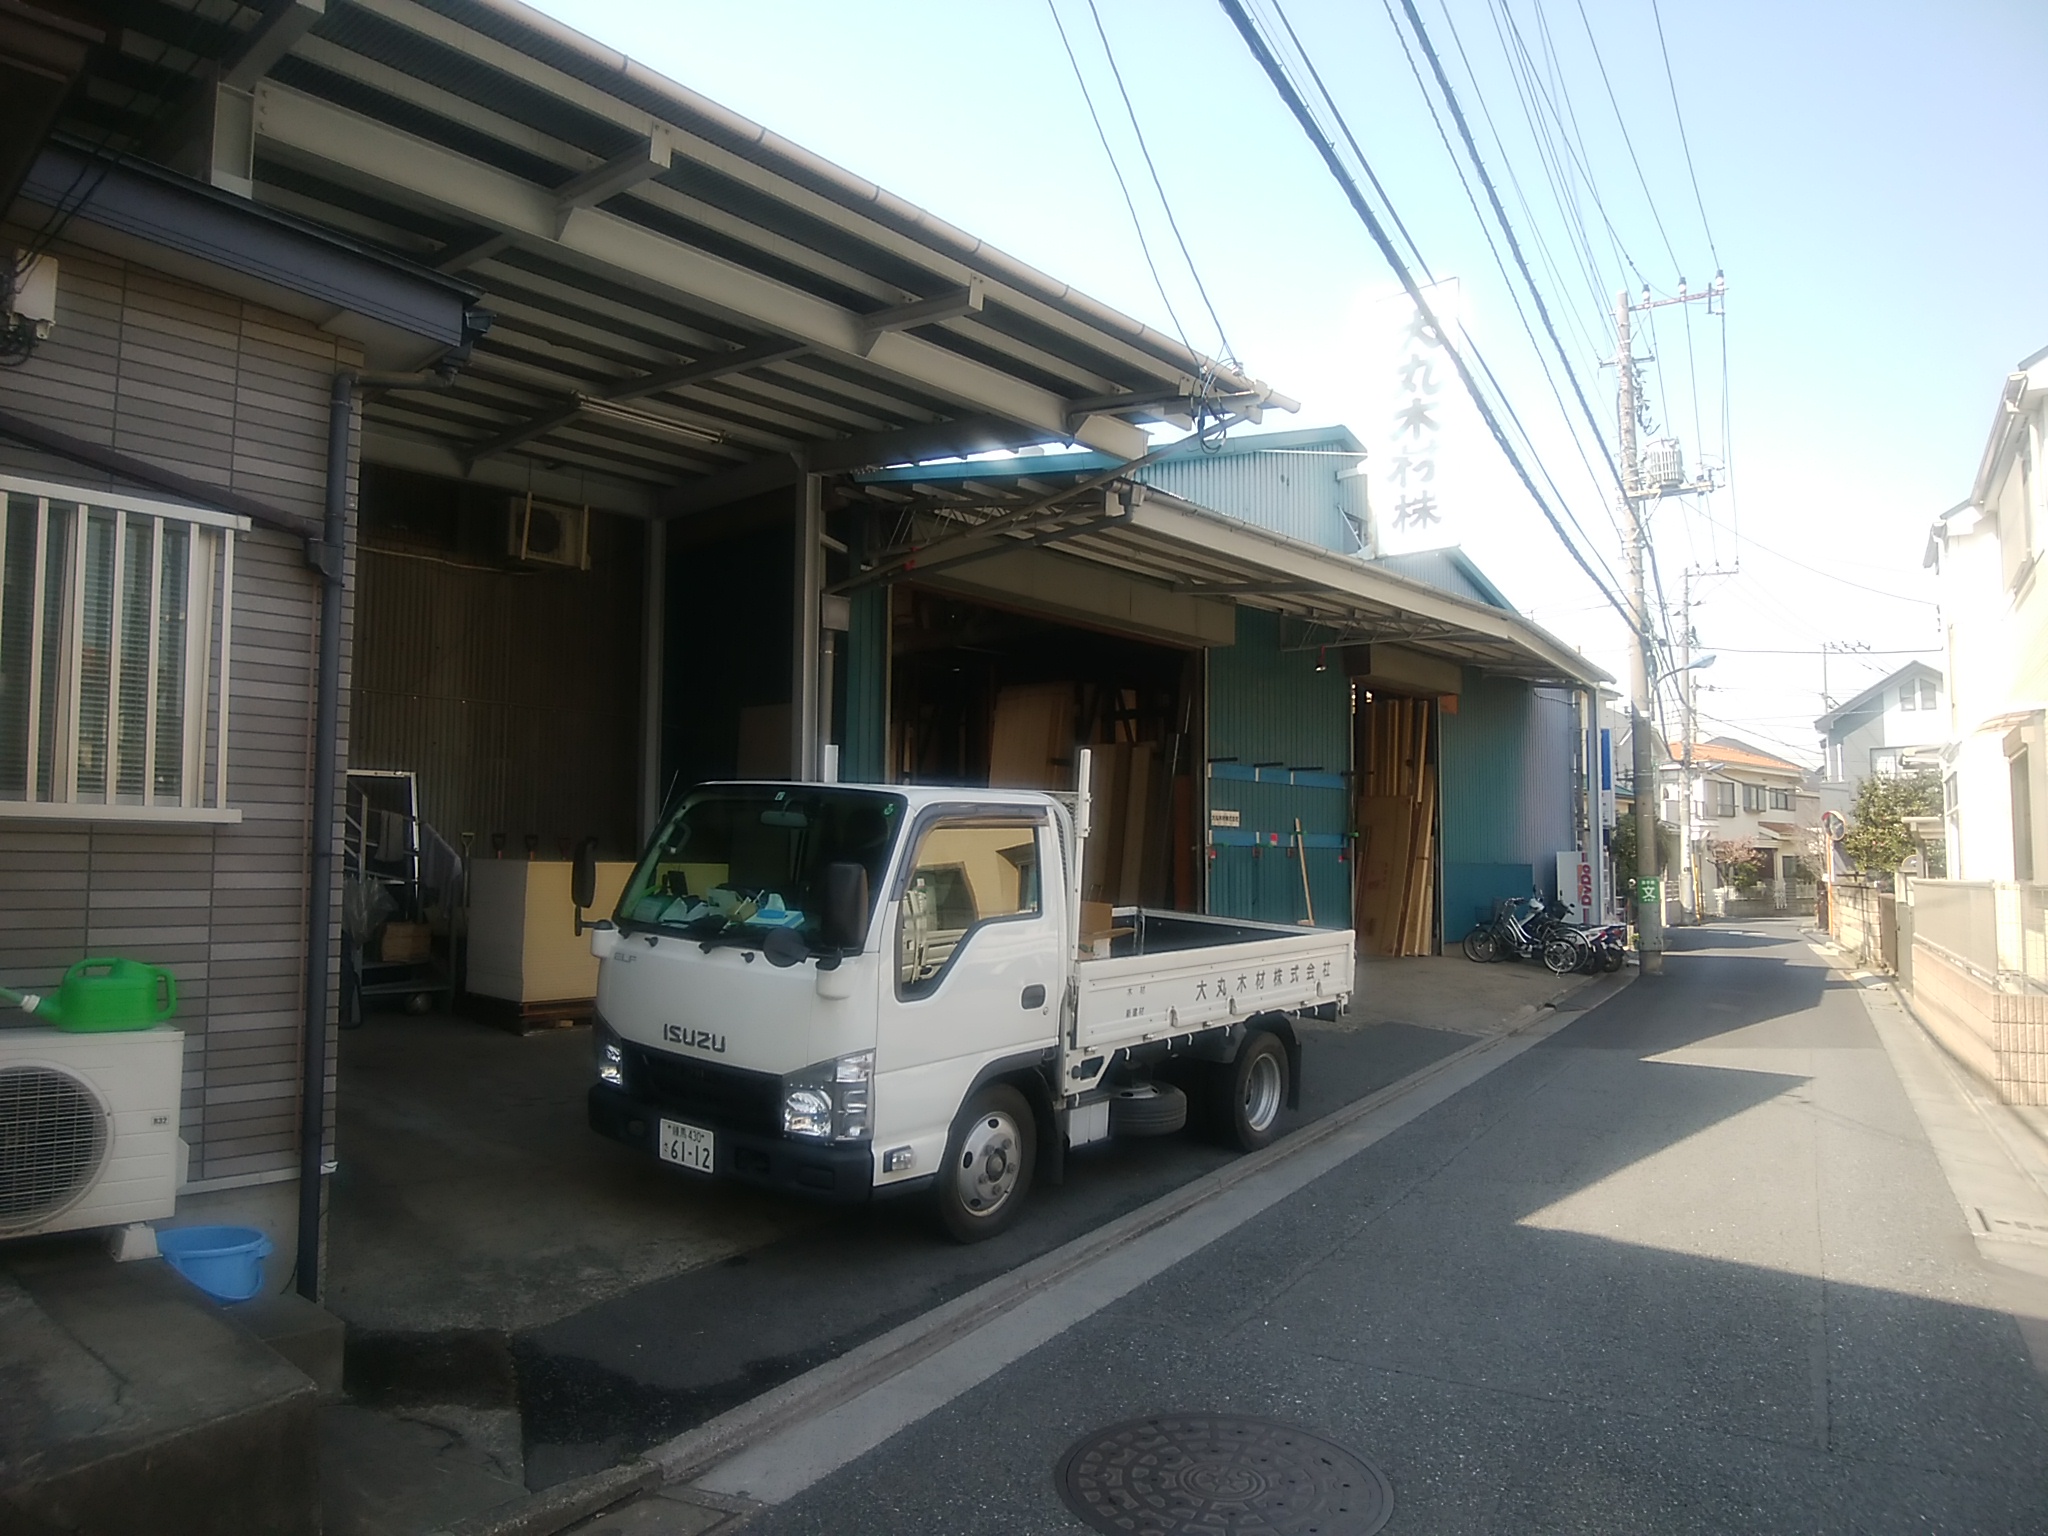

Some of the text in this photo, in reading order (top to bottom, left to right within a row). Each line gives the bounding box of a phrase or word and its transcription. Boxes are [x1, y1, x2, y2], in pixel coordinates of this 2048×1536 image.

[1195, 960, 1332, 1002] 大丸木材株式会社
[663, 1023, 727, 1053] ISUZU
[687, 1129, 703, 1143] 430
[671, 1139, 710, 1169] 61-12
